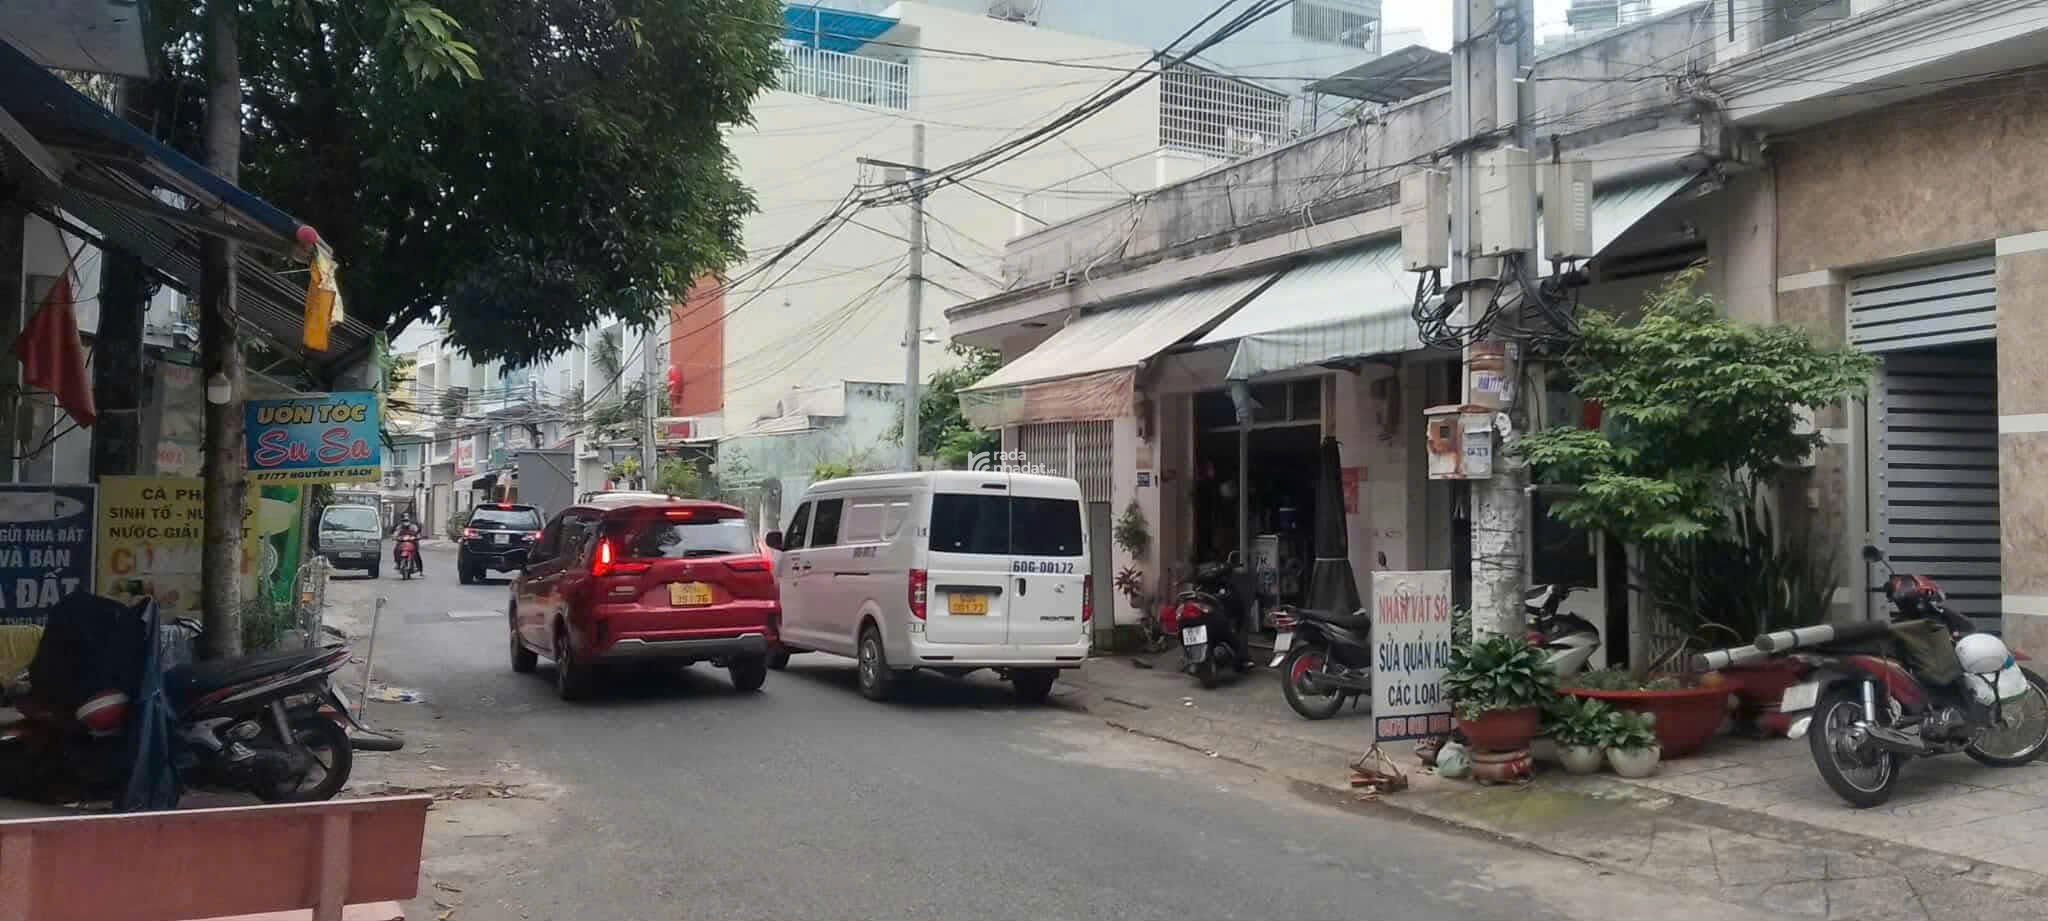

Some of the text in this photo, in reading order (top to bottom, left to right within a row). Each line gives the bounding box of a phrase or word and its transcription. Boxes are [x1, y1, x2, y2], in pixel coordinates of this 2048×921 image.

[257, 399, 367, 424] UỐN TÓC
[255, 426, 371, 467] Su Sa
[176, 488, 202, 500] PH
[109, 507, 145, 519] SINH
[1388, 678, 1440, 707] CÁC LOẠI
